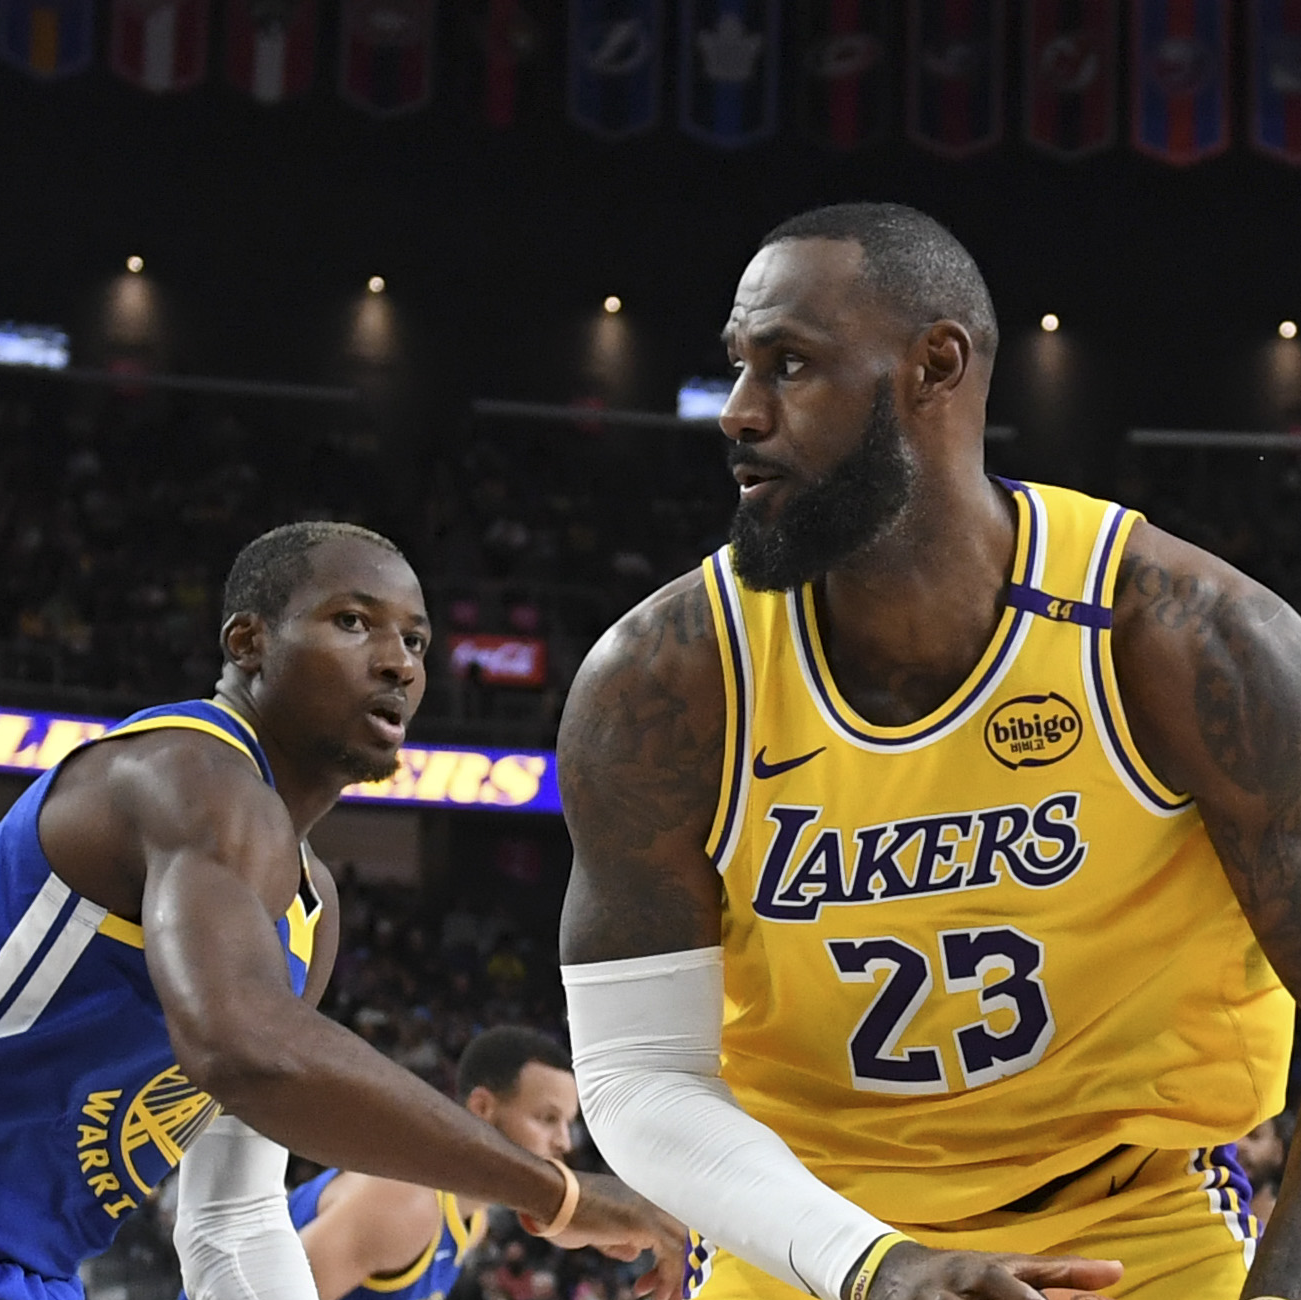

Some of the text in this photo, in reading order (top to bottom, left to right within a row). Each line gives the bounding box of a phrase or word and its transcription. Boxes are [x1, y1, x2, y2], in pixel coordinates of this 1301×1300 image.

[1046, 600, 1074, 619] 44
[992, 713, 1076, 744] bibigo
[751, 791, 1091, 924] LAKERS
[821, 924, 1057, 1095] 23
